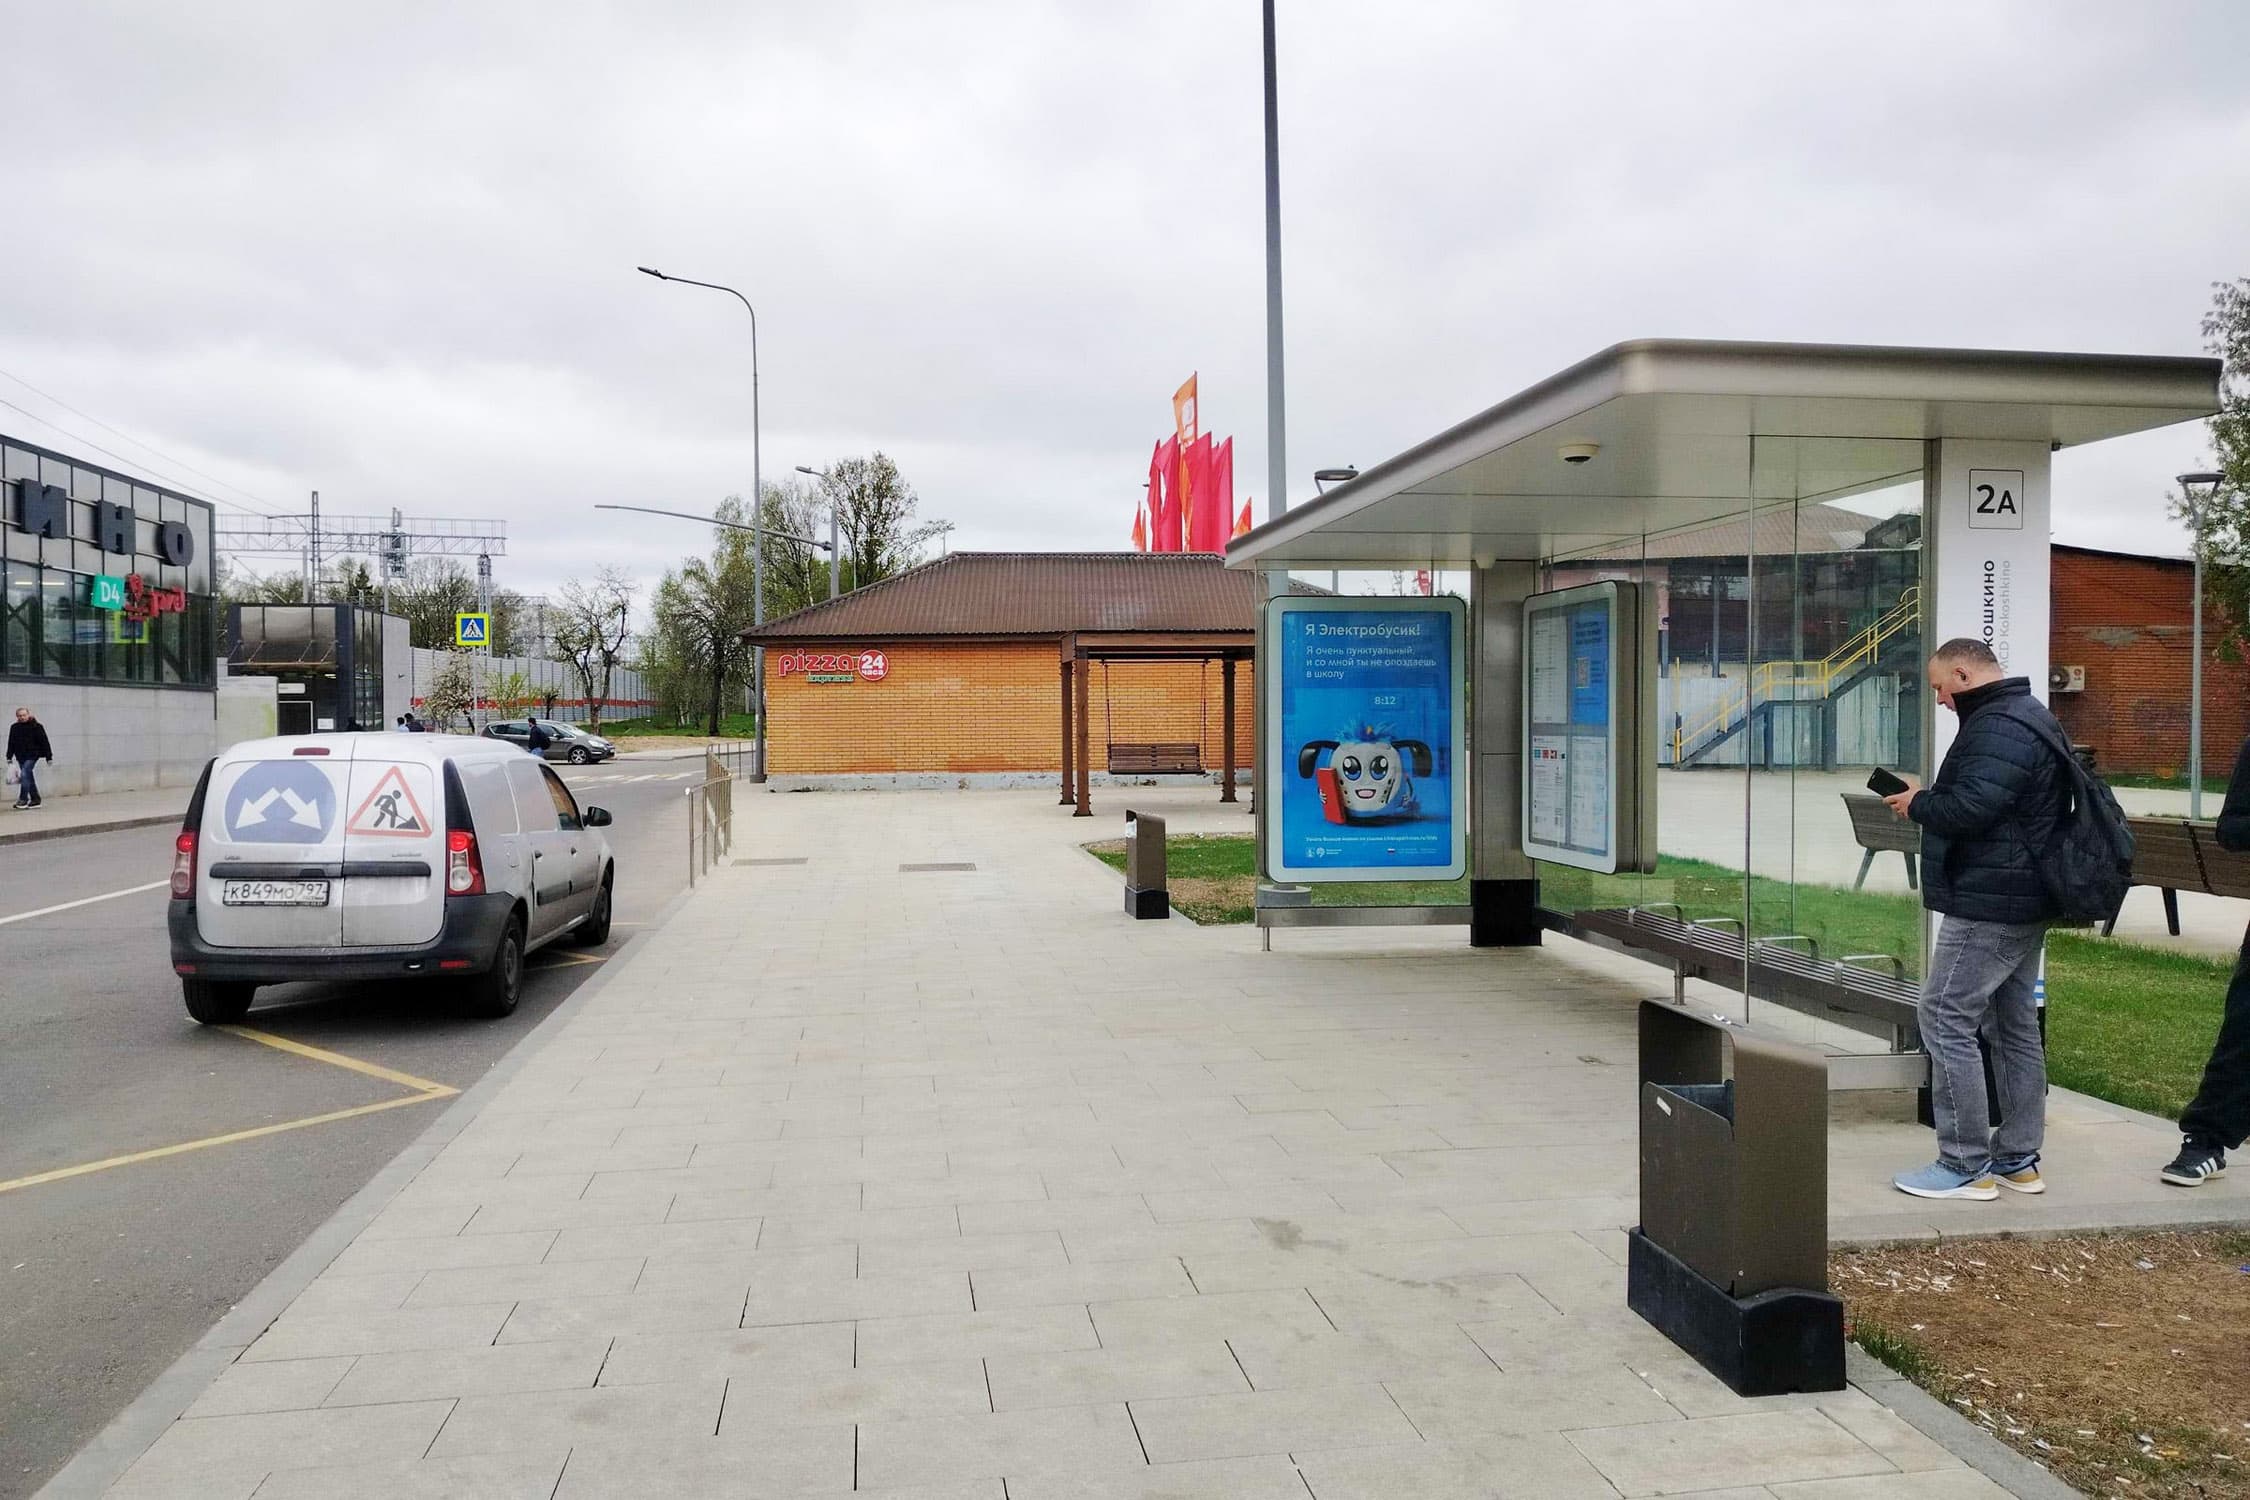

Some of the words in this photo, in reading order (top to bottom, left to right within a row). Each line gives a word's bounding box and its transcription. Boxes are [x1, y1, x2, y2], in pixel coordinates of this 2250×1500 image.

[1976, 483, 2016, 514] 2А
[100, 581, 120, 605] D4
[2000, 560, 2010, 637] Kokoshkino
[1305, 623, 1315, 636] Я
[1319, 623, 1421, 638] Электробусик!
[1306, 646, 1313, 655] Я
[1315, 647, 1344, 655] очень
[778, 648, 854, 676] pizza
[861, 655, 884, 669] 24
[1328, 658, 1354, 666] мной
[1314, 671, 1344, 679] школу
[1374, 696, 1396, 705] 8:12
